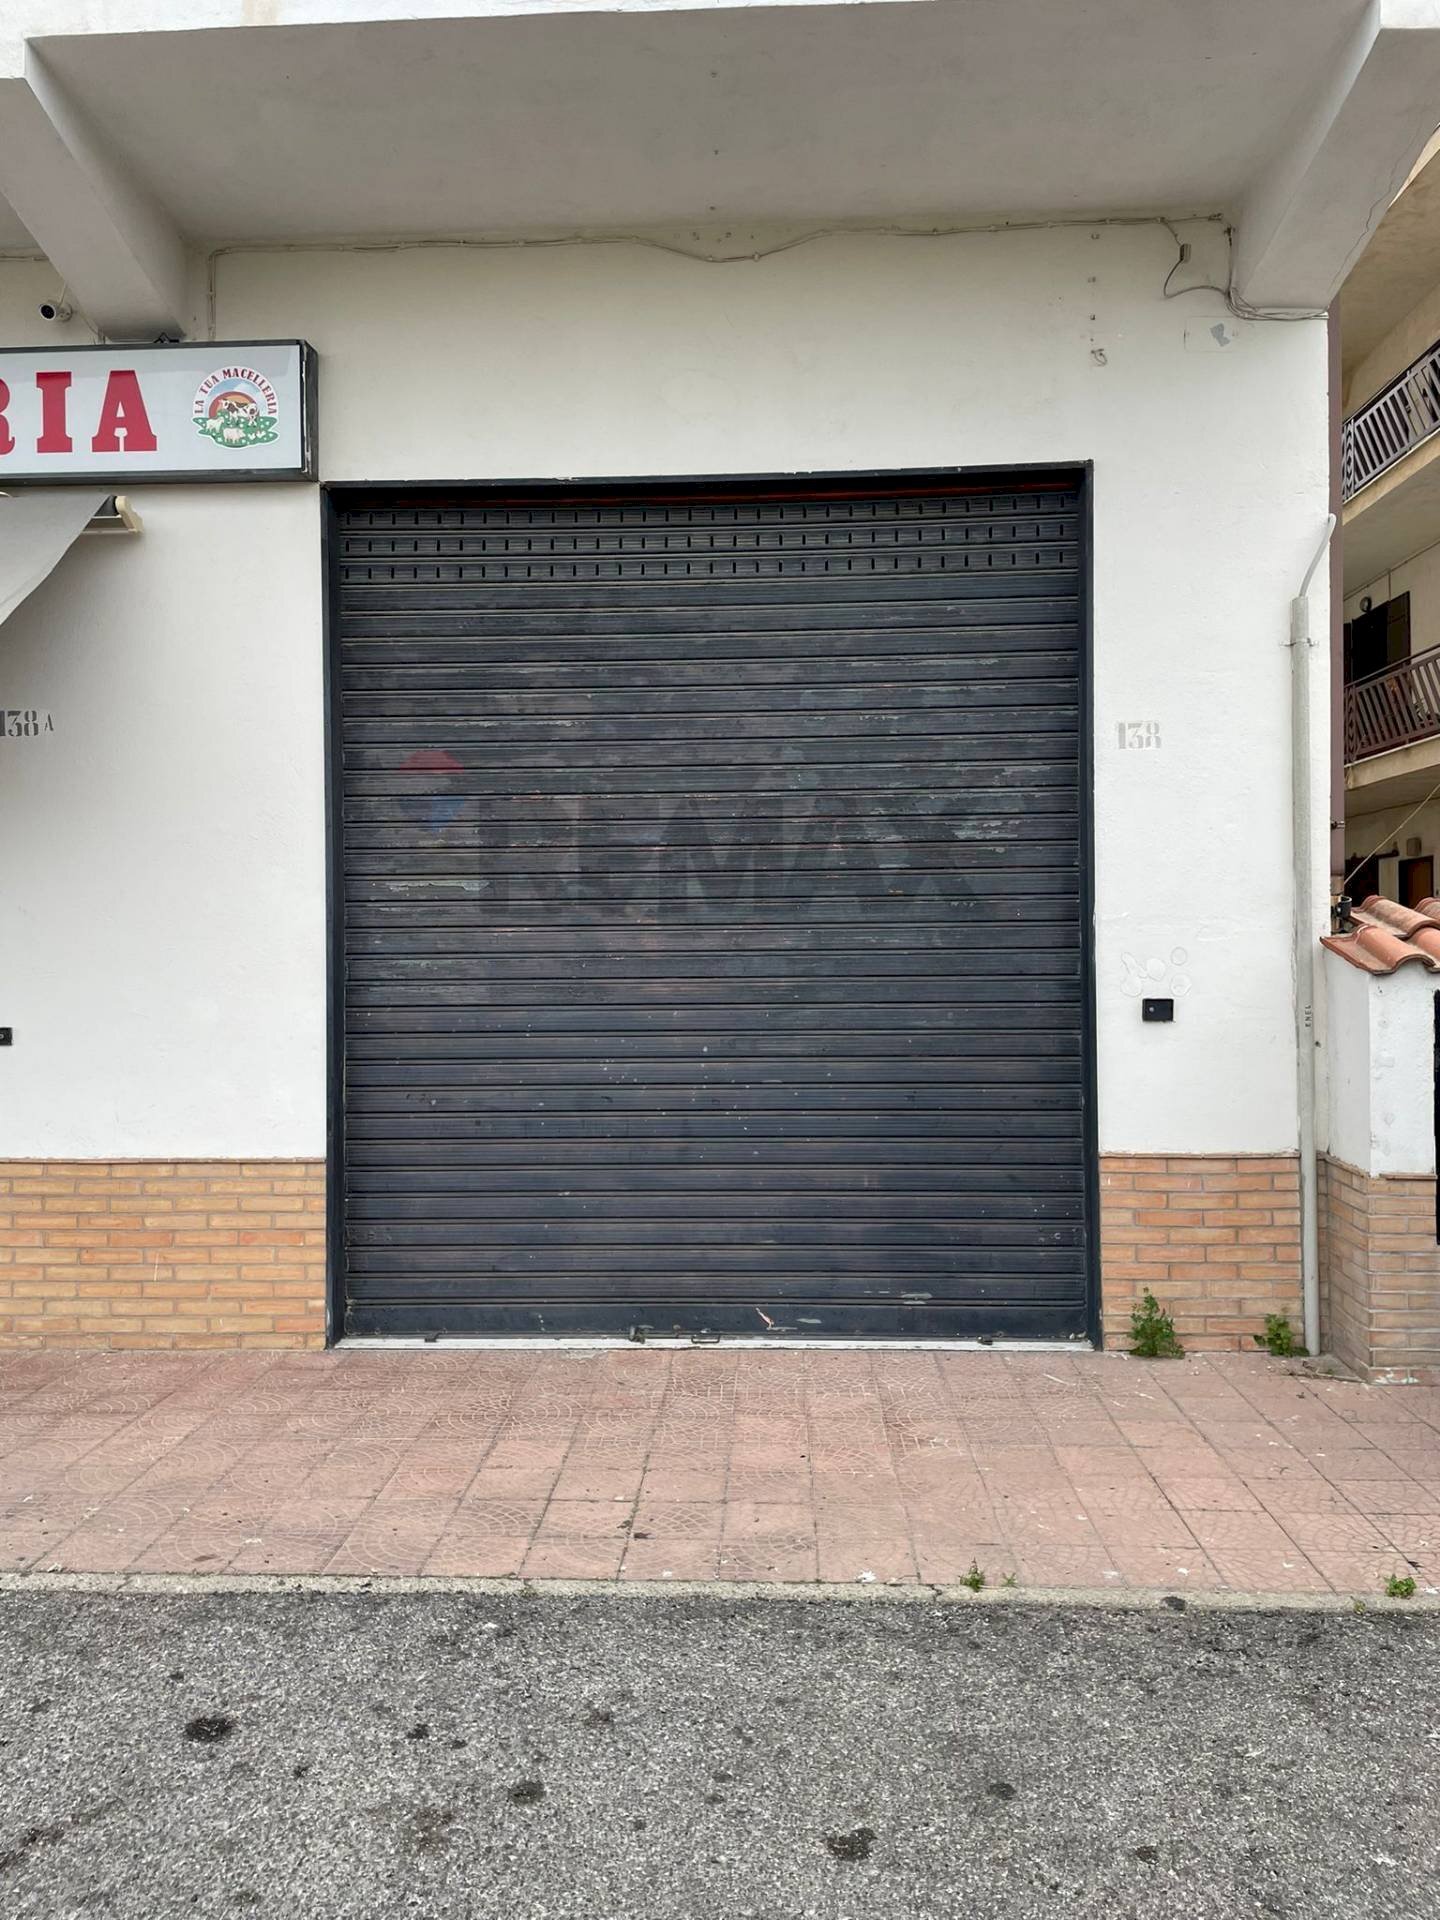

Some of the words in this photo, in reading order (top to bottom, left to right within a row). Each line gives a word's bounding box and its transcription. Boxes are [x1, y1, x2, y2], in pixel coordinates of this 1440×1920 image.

[0, 370, 157, 455] IA
[194, 400, 204, 414] LA
[199, 375, 220, 394] TUA
[222, 367, 277, 415] MACELLERIA
[1118, 722, 1161, 749] 138
